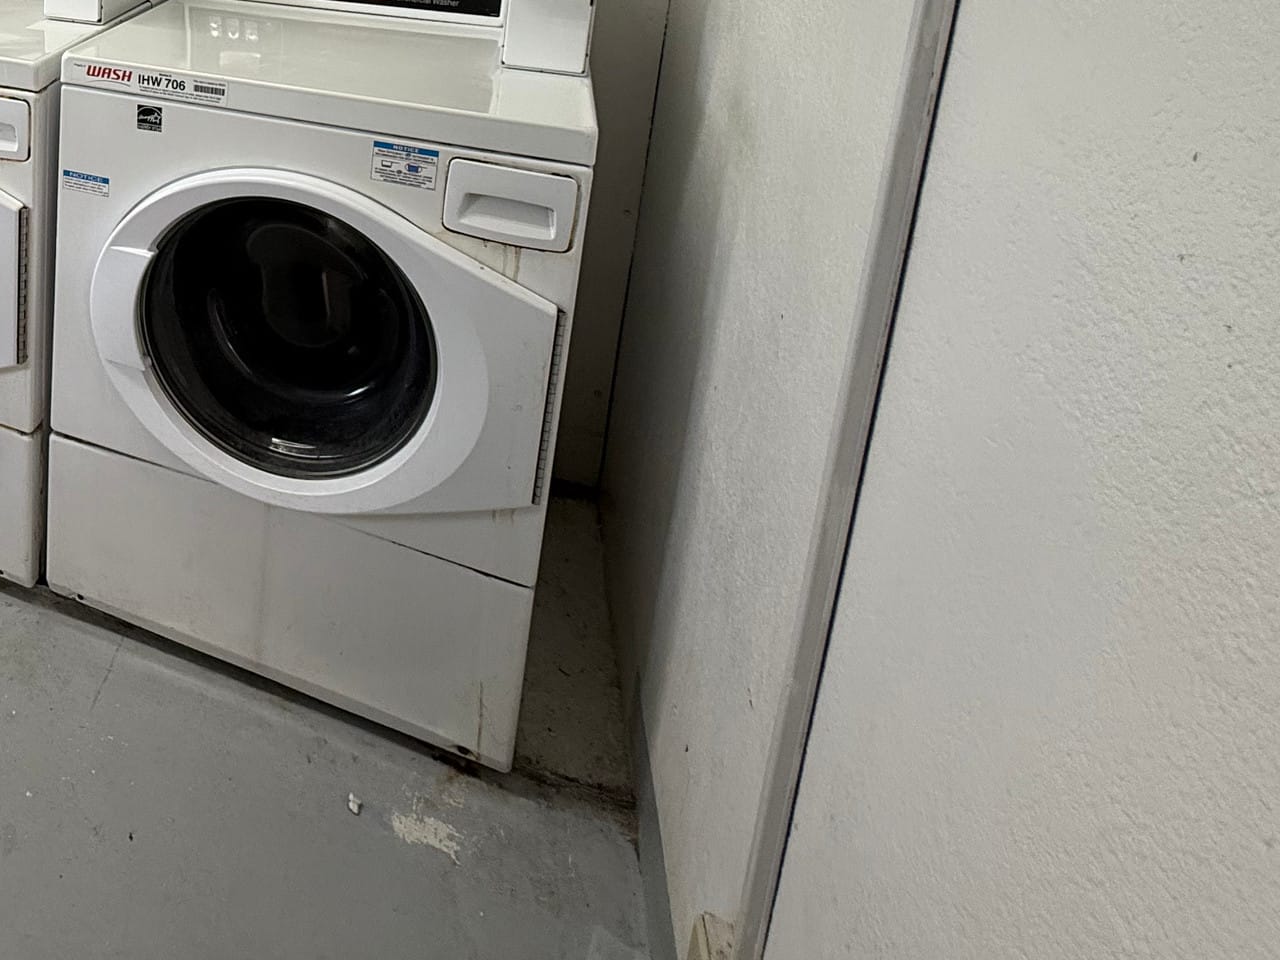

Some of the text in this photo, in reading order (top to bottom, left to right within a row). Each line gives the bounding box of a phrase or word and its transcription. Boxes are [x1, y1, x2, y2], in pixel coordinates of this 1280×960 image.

[86, 64, 186, 91] WASH IHW 706
